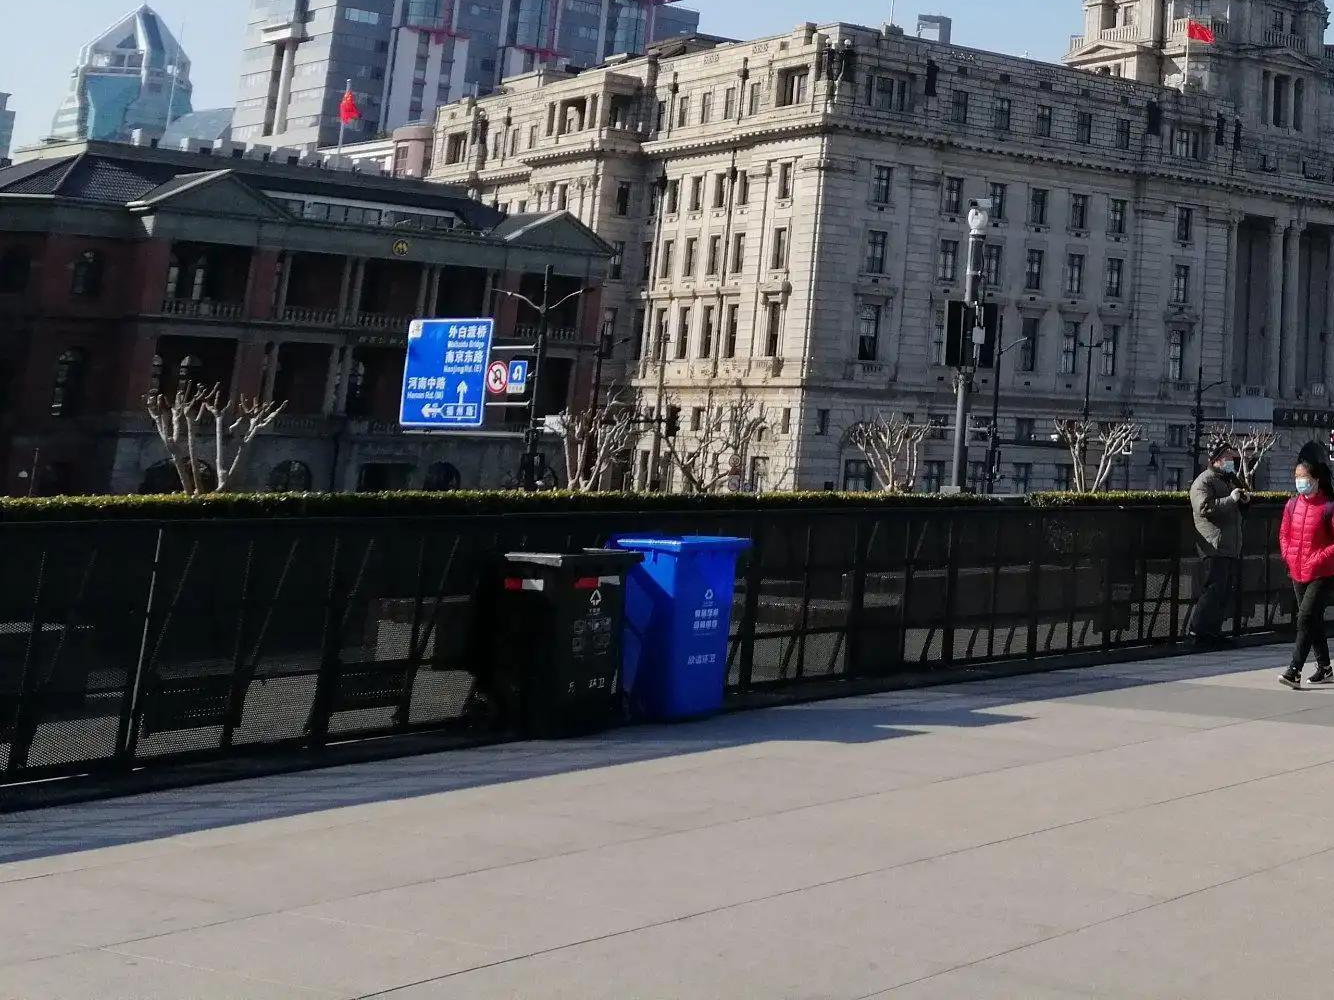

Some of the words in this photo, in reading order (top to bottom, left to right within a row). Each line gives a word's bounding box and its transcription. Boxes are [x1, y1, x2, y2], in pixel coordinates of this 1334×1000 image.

[449, 325, 487, 338] 外白渡桥
[445, 350, 484, 364] 南京东路
[407, 377, 446, 390] 河南中路
